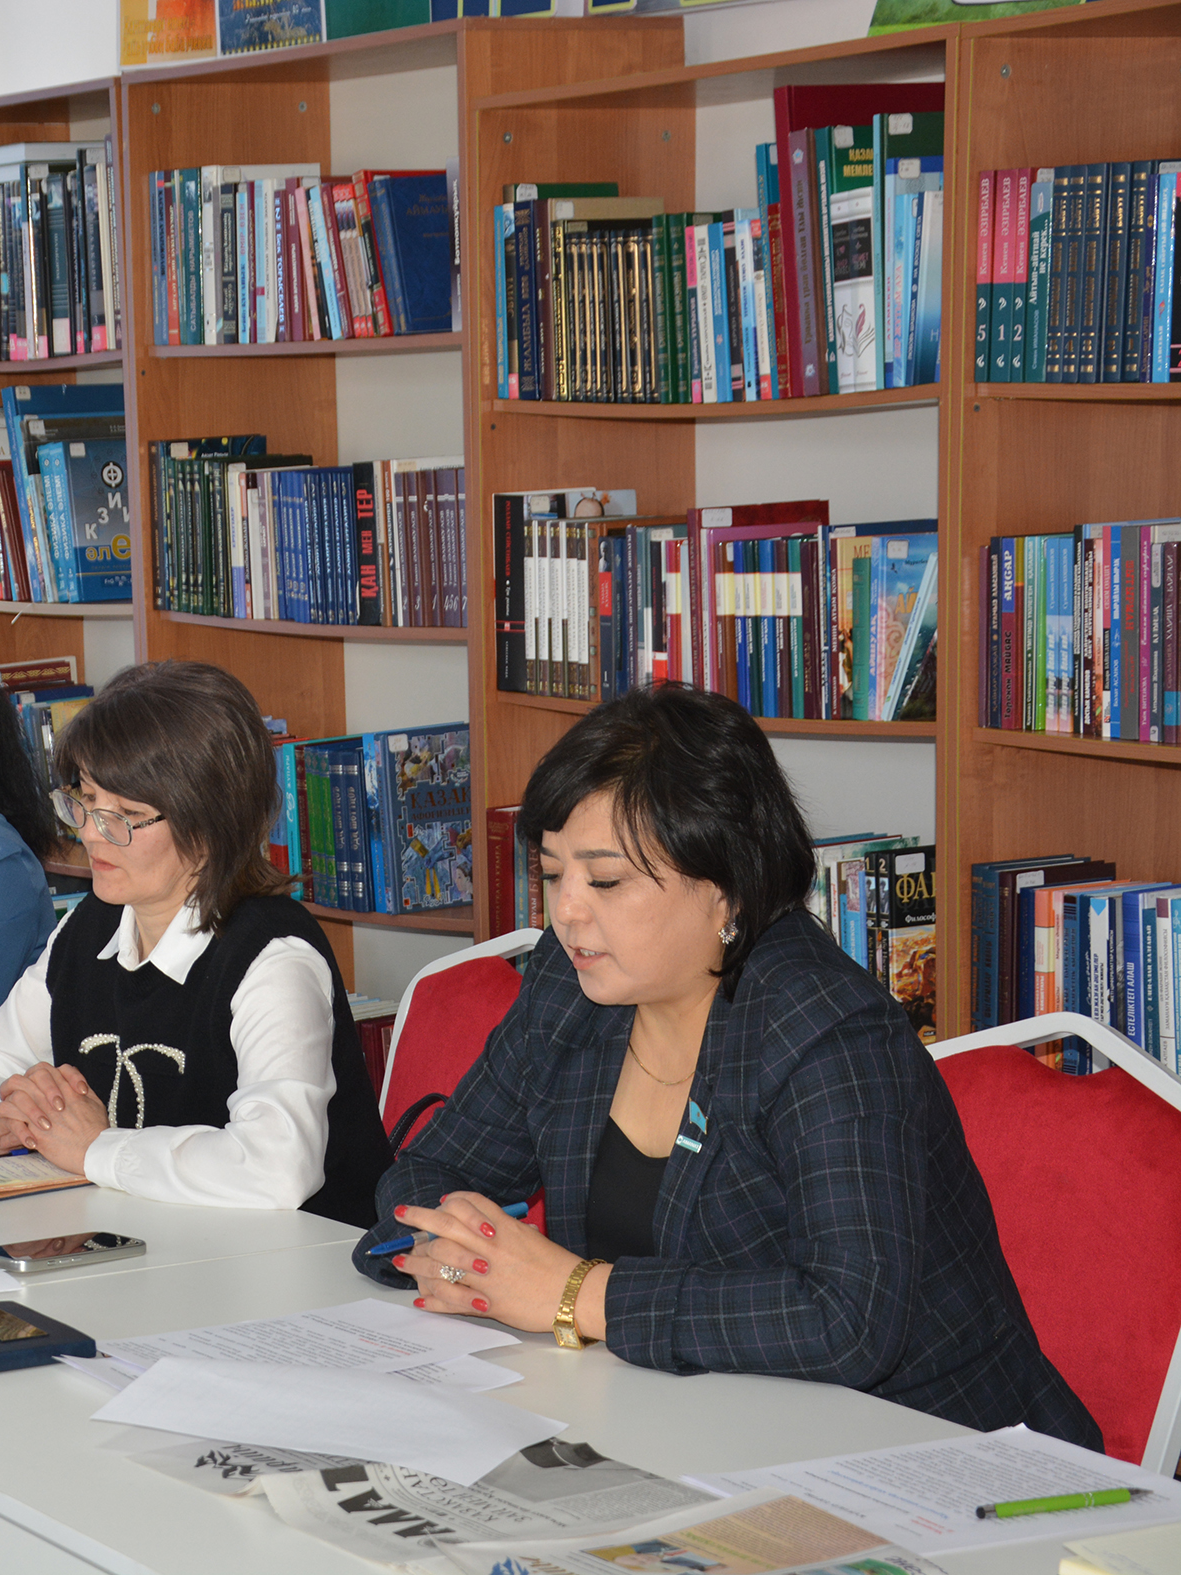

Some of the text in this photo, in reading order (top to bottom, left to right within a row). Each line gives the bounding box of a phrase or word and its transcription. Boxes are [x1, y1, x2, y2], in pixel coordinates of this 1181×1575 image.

[980, 177, 990, 275] Кенен ӘЗІРБАЕВ
[1000, 177, 1011, 275] Кенен ӘЗІРБАЕВ
[1017, 177, 1027, 275] Кенен ӘЗІРБАЕВ
[188, 210, 197, 332] САТЫБАЛДЫ НАРЫМБЕТОВ
[1028, 231, 1040, 305] Айтып-айтпай
[521, 303, 532, 372] ЖАМБЫЛ
[977, 324, 986, 341] 5
[1013, 324, 1022, 341] 2
[49, 512, 60, 560] ФИЗИКА
[59, 512, 70, 560] ФИЗИКА
[85, 533, 131, 560] әле
[356, 488, 378, 598] ҚАН МЕН ТЕР
[1003, 550, 1015, 602] АҢСАР
[1125, 560, 1135, 631] ШЫТЫРМАН
[1127, 962, 1136, 1036] ЕСТЕЛІКТЕГІ АЛАШ
